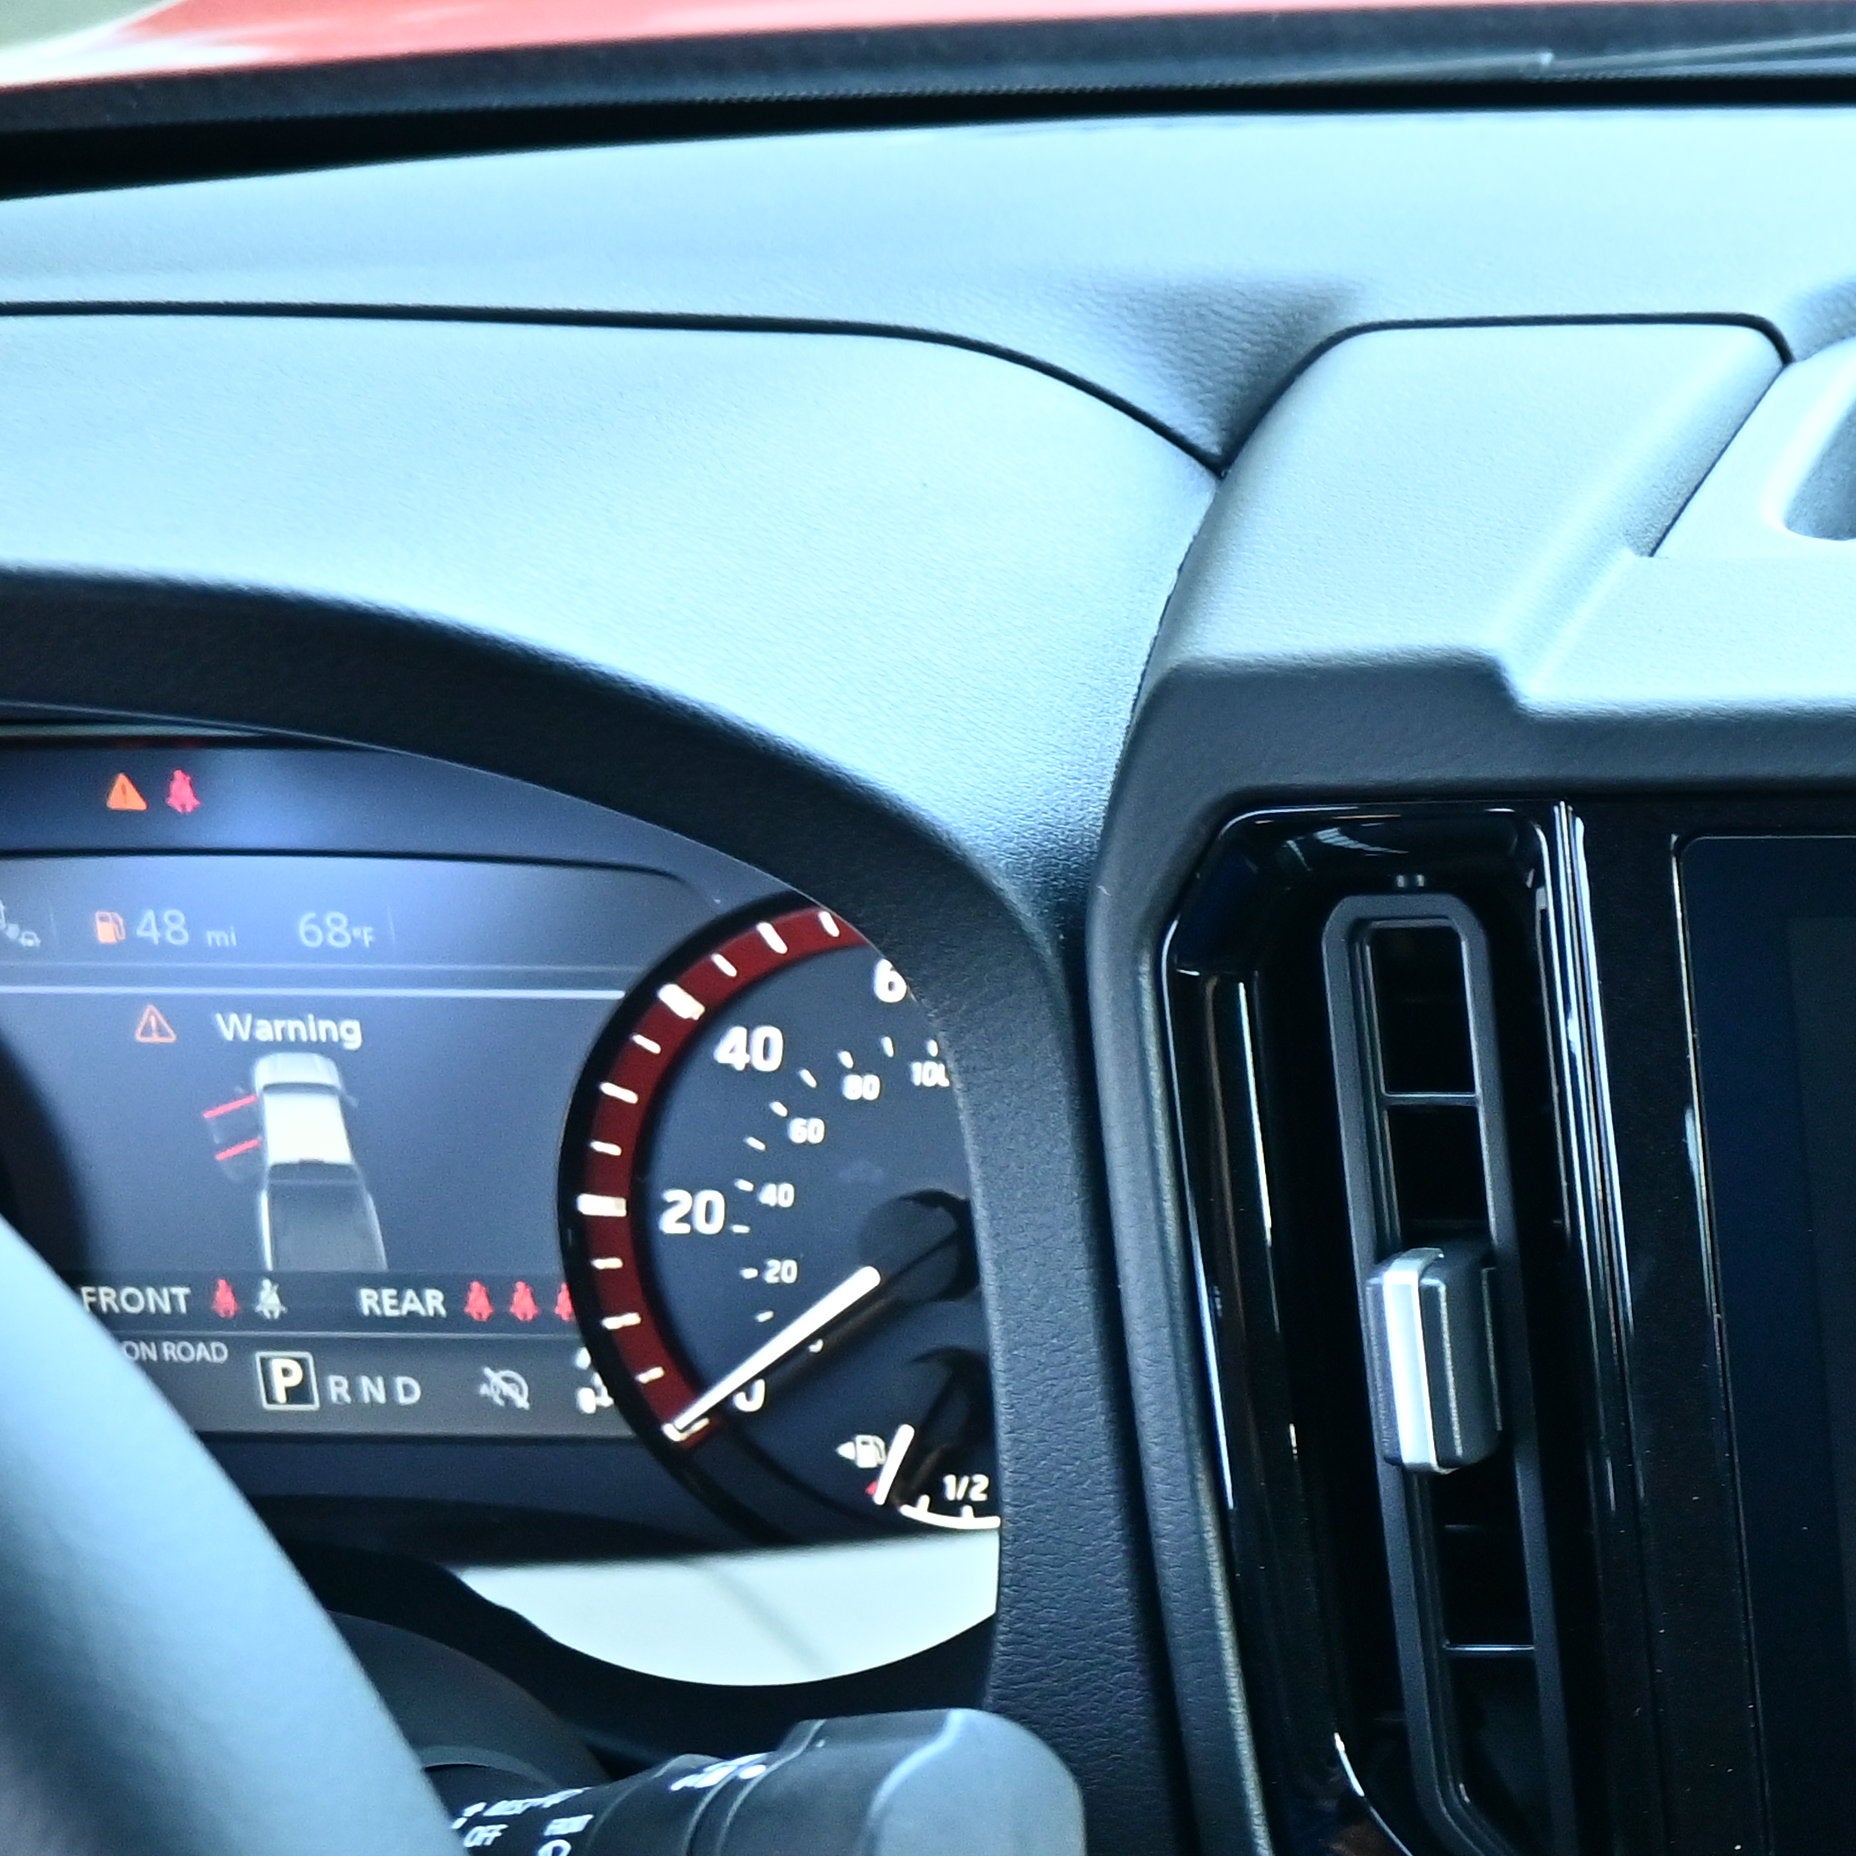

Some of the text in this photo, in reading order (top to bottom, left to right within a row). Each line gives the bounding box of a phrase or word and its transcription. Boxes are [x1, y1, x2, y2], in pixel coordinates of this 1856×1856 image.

[136, 909, 238, 948] 48 mi
[873, 958, 907, 1004] 6
[214, 1012, 363, 1051] Warning
[714, 1025, 784, 1072] 40
[842, 1073, 881, 1101] 80
[787, 1117, 825, 1144] 60
[758, 1182, 795, 1208] 40
[659, 1188, 726, 1235] 20
[763, 1259, 798, 1284] 20
[80, 1285, 191, 1315] FRONT
[360, 1288, 448, 1318] REAR
[122, 1340, 228, 1364] ON ROAD
[271, 1358, 422, 1405] P R N D
[942, 1473, 990, 1502] 1/2
